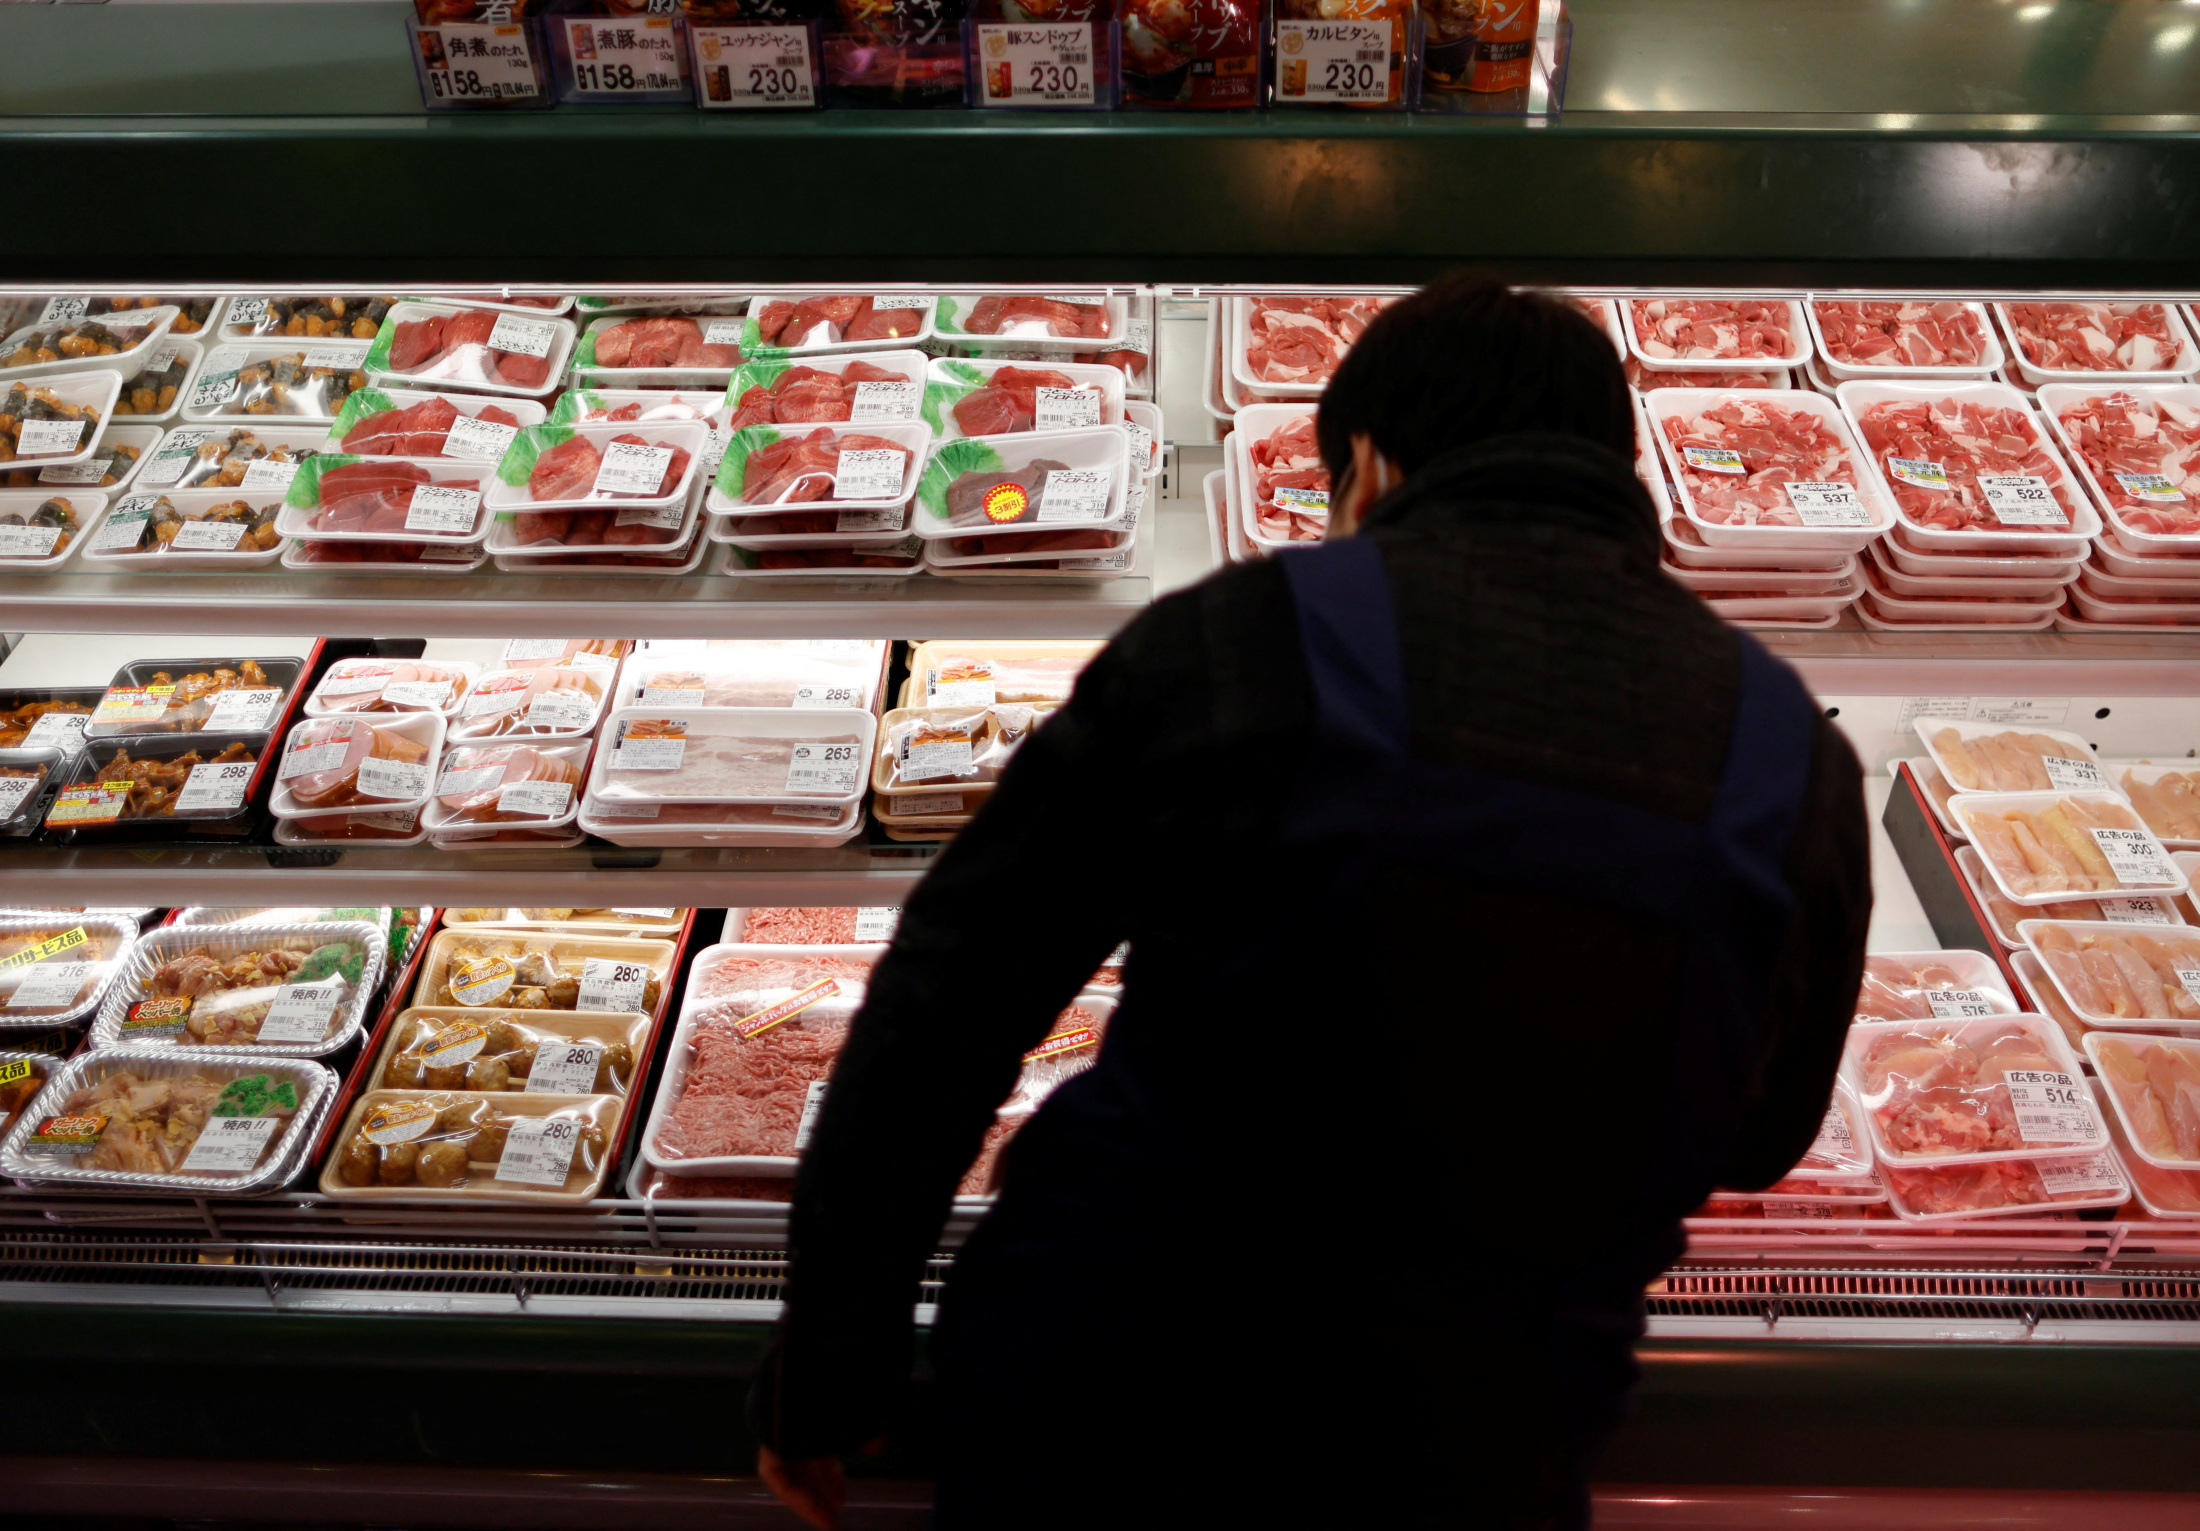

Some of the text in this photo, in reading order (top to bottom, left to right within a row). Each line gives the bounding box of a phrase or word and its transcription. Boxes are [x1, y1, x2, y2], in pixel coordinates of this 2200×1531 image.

[597, 30, 673, 50] 煮豚のたれ
[1007, 30, 1082, 45] 豚スンドゥブ
[450, 37, 524, 58] 角煮のたれ
[1030, 67, 1089, 93] 230 円
[1327, 64, 1386, 91] 230 円
[750, 69, 809, 99] 230 円
[1823, 493, 1849, 503] 537
[2017, 489, 2046, 499] 522
[248, 693, 272, 705] 298
[826, 688, 851, 701] 285
[2047, 757, 2097, 770] 広告の品
[220, 767, 247, 779] 298
[2074, 769, 2097, 780] 331
[1, 780, 29, 792] 298
[2096, 830, 2146, 841] 広告の品
[2127, 843, 2152, 855] 300
[2127, 900, 2153, 911] 323
[58, 965, 85, 978] 316
[1930, 991, 1982, 1002] 広告の品
[140, 999, 183, 1010] ガーリック
[627, 1004, 640, 1012] 280
[2010, 1071, 2073, 1085] 広告の品
[51, 1117, 98, 1128] ガーリック
[553, 1162, 568, 1170] 280
